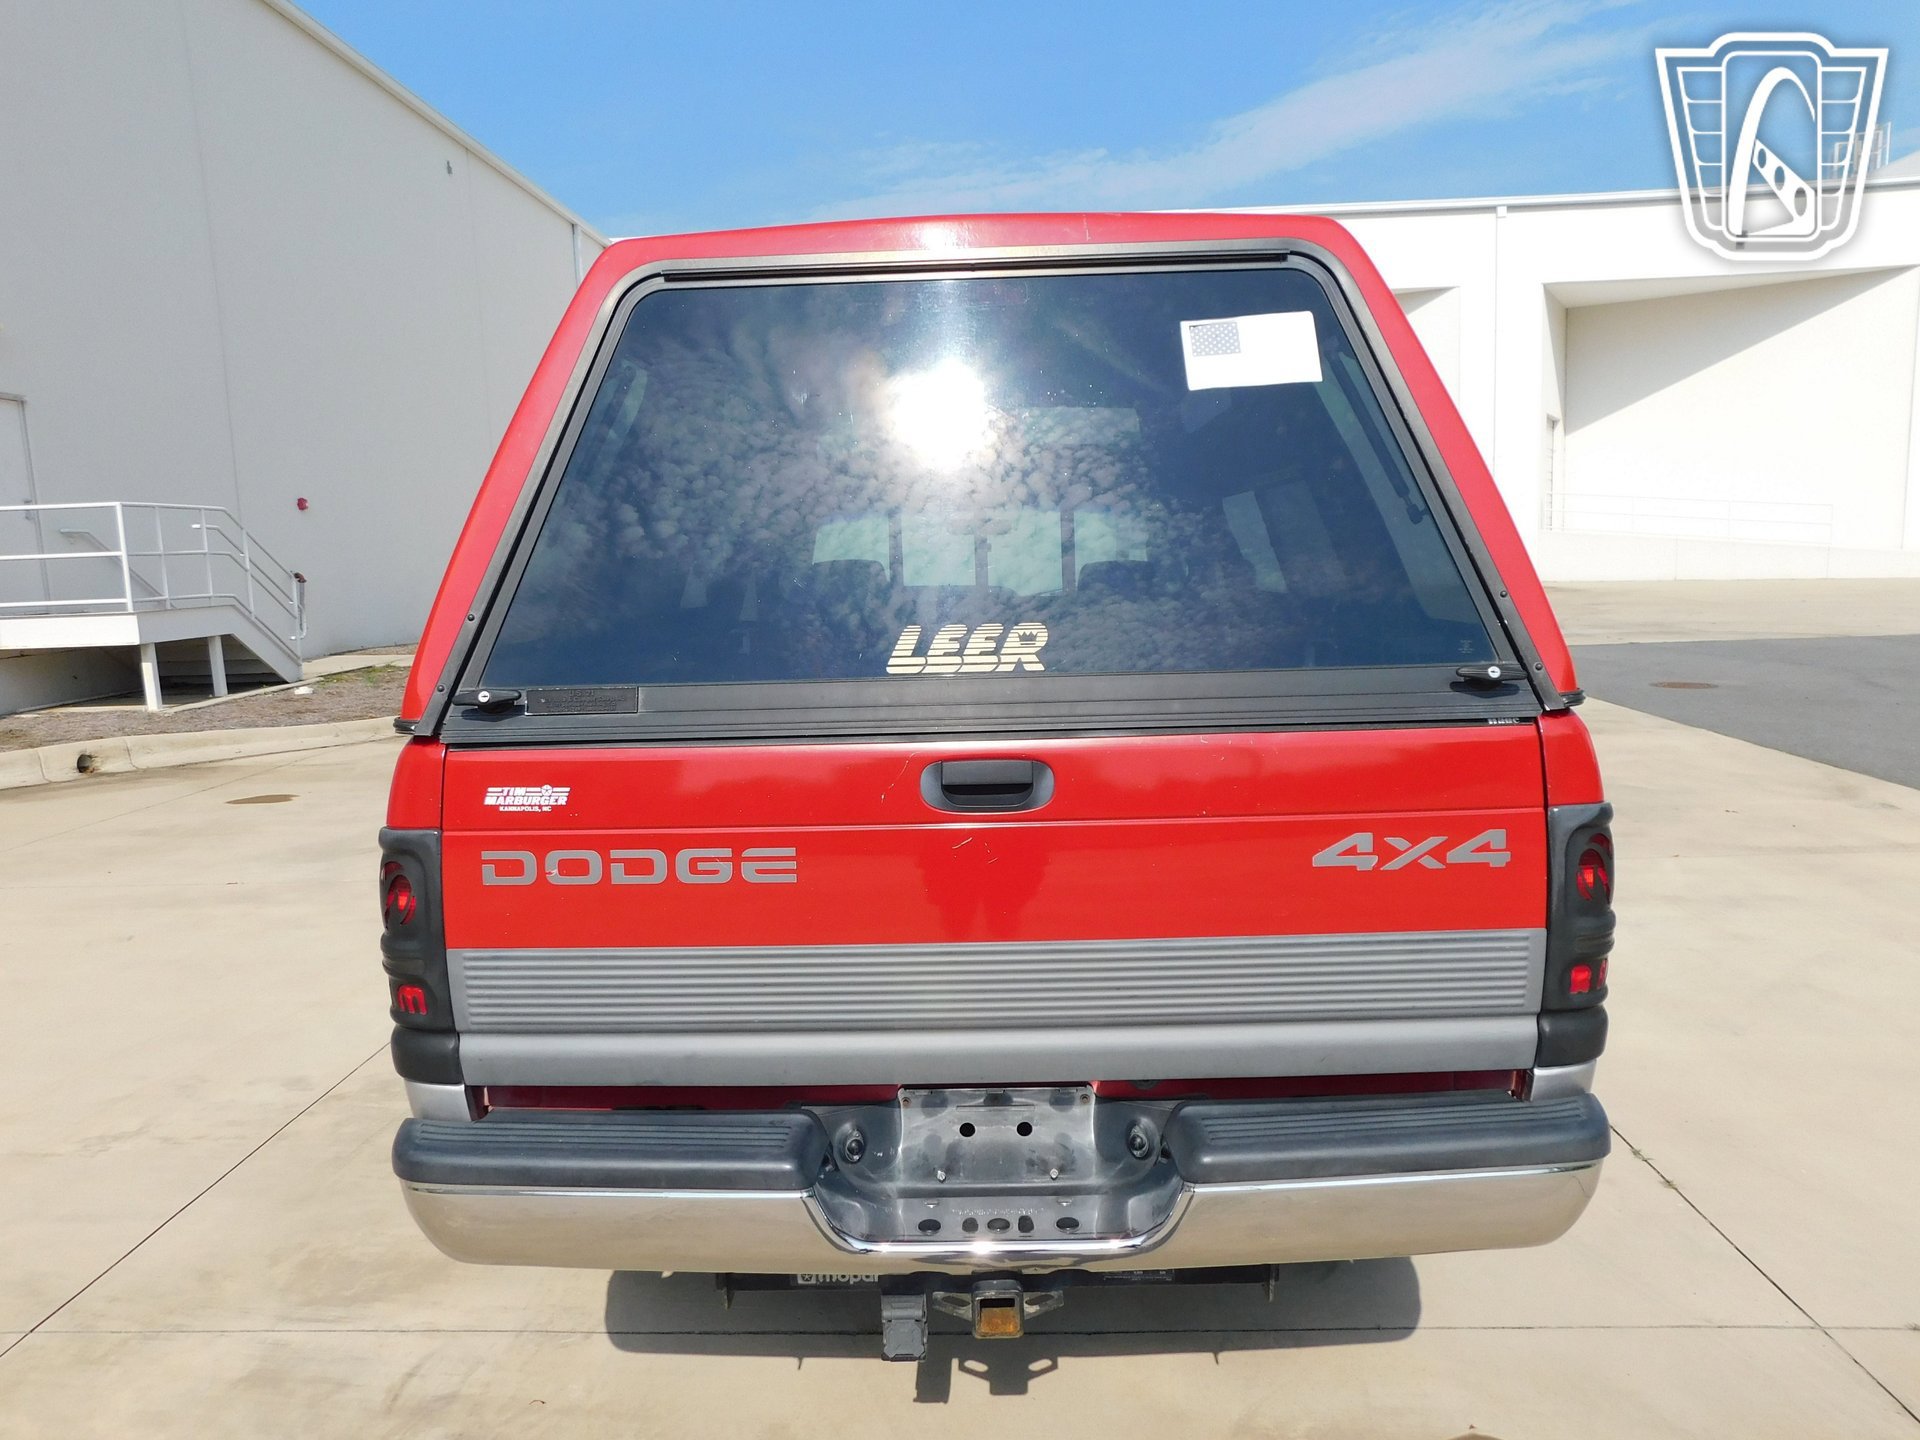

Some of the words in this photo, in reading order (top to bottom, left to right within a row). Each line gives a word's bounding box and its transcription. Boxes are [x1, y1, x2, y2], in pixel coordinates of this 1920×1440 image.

[886, 622, 1049, 674] LEER
[484, 796, 568, 806] MARBURGER
[501, 787, 527, 796] TIM
[481, 848, 797, 885] DODGE
